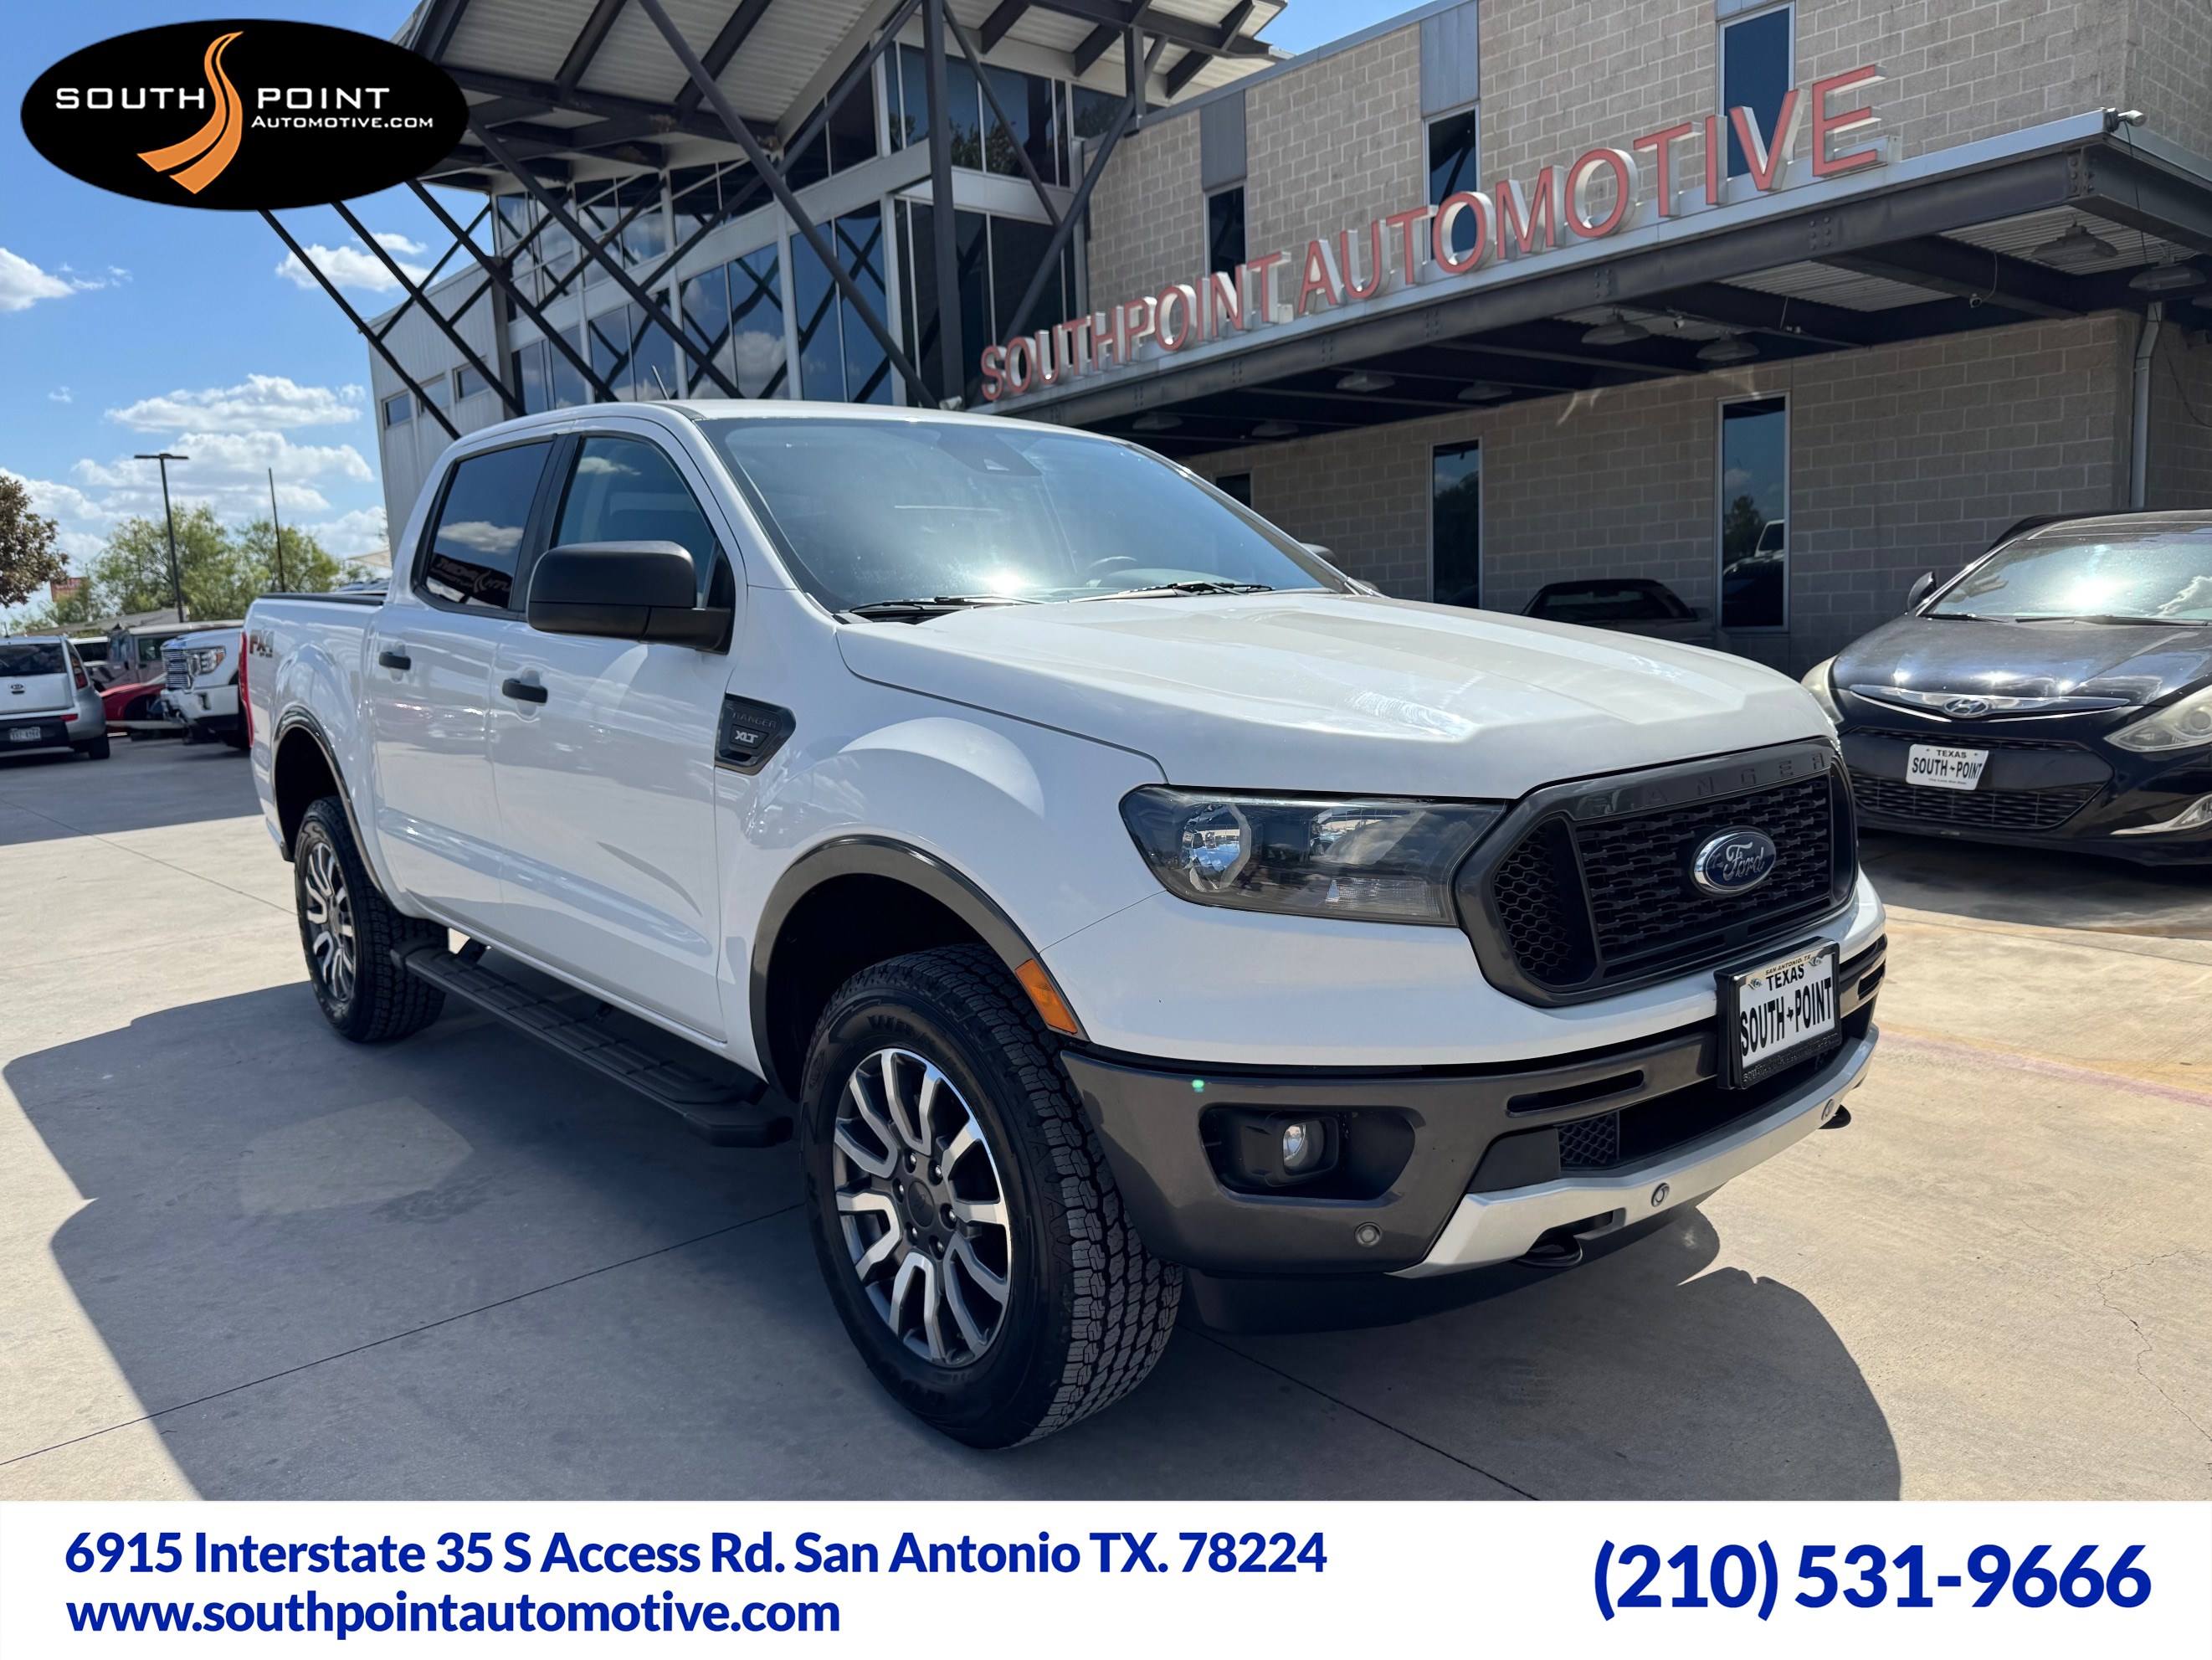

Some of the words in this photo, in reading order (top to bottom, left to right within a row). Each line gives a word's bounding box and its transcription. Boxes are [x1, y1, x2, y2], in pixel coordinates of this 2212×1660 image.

[1298, 64, 1890, 315] AUTOMOTIVE
[732, 712, 777, 727] RANGER
[735, 730, 758, 743] XLT
[1936, 749, 1967, 758] TEXAS
[1912, 757, 1948, 776] SOUTH
[1956, 761, 1983, 779] POINT
[1722, 842, 1764, 881] Ford
[1765, 967, 1777, 975] SAN
[1766, 964, 1804, 990] TEXAS
[1740, 996, 1785, 1056] SOUTH
[1794, 977, 1831, 1032] POINT
